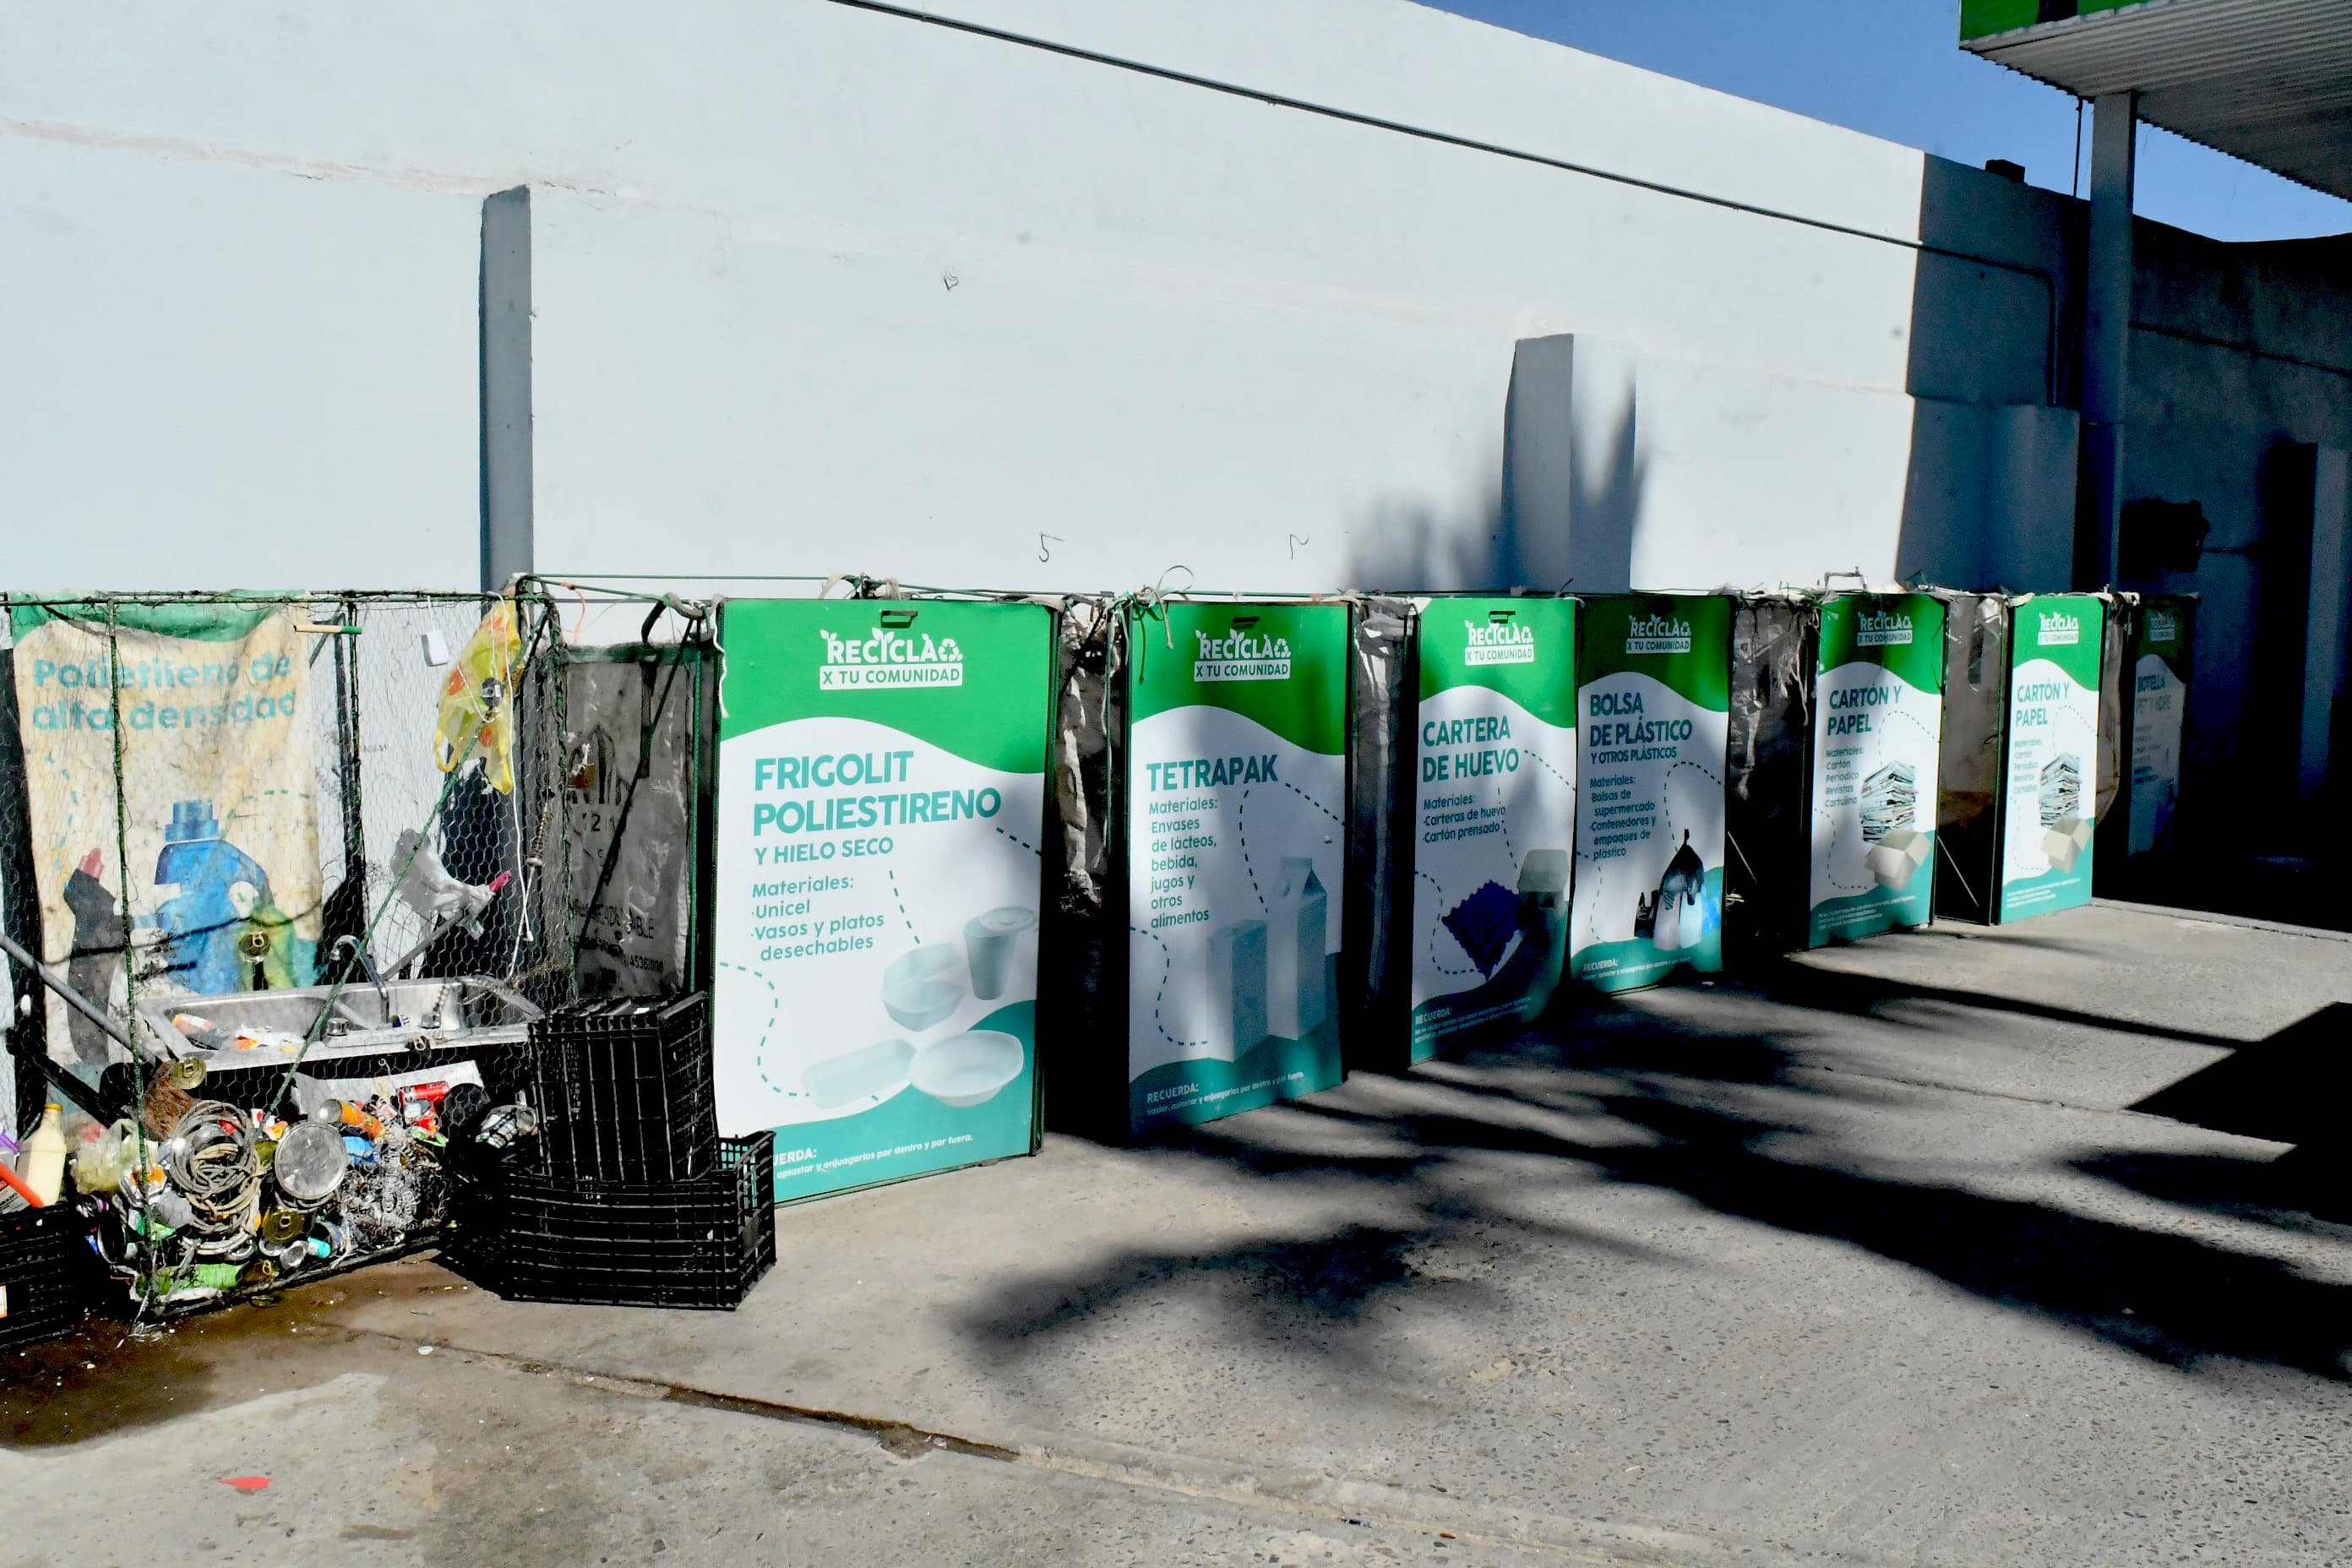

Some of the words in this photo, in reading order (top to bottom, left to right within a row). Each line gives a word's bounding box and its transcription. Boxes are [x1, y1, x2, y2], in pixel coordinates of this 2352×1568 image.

[1474, 650, 1484, 660] TU
[1487, 648, 1532, 660] COMUNIDAD
[1646, 640, 1689, 650] COMUNIDAD
[35, 656, 239, 689] Polietileno
[251, 651, 292, 681] de
[823, 672, 832, 684] X
[839, 671, 859, 683] TU
[866, 668, 960, 683] COMUNIDAD
[1196, 666, 1202, 677] X
[1207, 665, 1221, 677] TU
[1224, 662, 1288, 677] COMUNIDAD
[1829, 683, 1889, 710] CARTÓN
[1894, 685, 1903, 703] Y
[2017, 678, 2060, 703] CARTÓN
[2062, 682, 2070, 698] Y
[1590, 692, 1643, 716] BOLSA
[33, 700, 115, 730] alta
[1827, 714, 1872, 735] PAPEL
[2016, 708, 2048, 727] PAPEL
[1423, 716, 1511, 747] CARTERA
[1590, 724, 1612, 747] DE
[1616, 716, 1692, 744] PLÁSTICO
[1591, 754, 1597, 764] Y
[1598, 749, 1628, 763] OTROS
[1631, 745, 1677, 760] PLÁSTICOS
[754, 751, 914, 791] FRIGOLIT
[1146, 754, 1277, 792] TETRAPAK
[1423, 754, 1449, 782] DE
[1455, 749, 1519, 779] HUEVO
[1590, 775, 1636, 788] Materiales:
[1424, 794, 1475, 810] Materiales:
[1620, 789, 1631, 799] de
[754, 787, 1001, 836] POLIESTIRENO
[1149, 798, 1217, 815] Materiales:
[1467, 808, 1478, 820] de
[1480, 805, 1506, 818] huevo
[1594, 801, 1655, 817] supermercado
[1152, 817, 1200, 834] Envases
[1652, 816, 1656, 826] y
[1458, 822, 1500, 841] prensado
[1593, 833, 1637, 846] empaques
[1641, 830, 1651, 839] de
[754, 847, 767, 865] Y
[774, 841, 836, 864] HIELO
[841, 836, 894, 858] SECO
[1152, 838, 1167, 852] de
[1171, 836, 1217, 851] lácteos,
[1152, 855, 1197, 872] bebida,
[752, 876, 854, 897] Materiales:
[1151, 877, 1184, 895] jugos
[1187, 875, 1195, 890] y
[755, 899, 810, 918] Unicel
[1151, 896, 1183, 910] otros
[814, 922, 825, 938] y
[830, 914, 884, 935] platos
[1151, 908, 1209, 929] alimentos
[760, 935, 874, 961] desechables
[1146, 1082, 1199, 1103] RECUERDA:
[777, 1164, 814, 1180] aplastar
[815, 1162, 823, 1174] y
[824, 1152, 875, 1170] enjuagarlos
[876, 1146, 892, 1160] por
[894, 1141, 923, 1154] dentro
[924, 1141, 930, 1152] y
[931, 1137, 947, 1151] por
